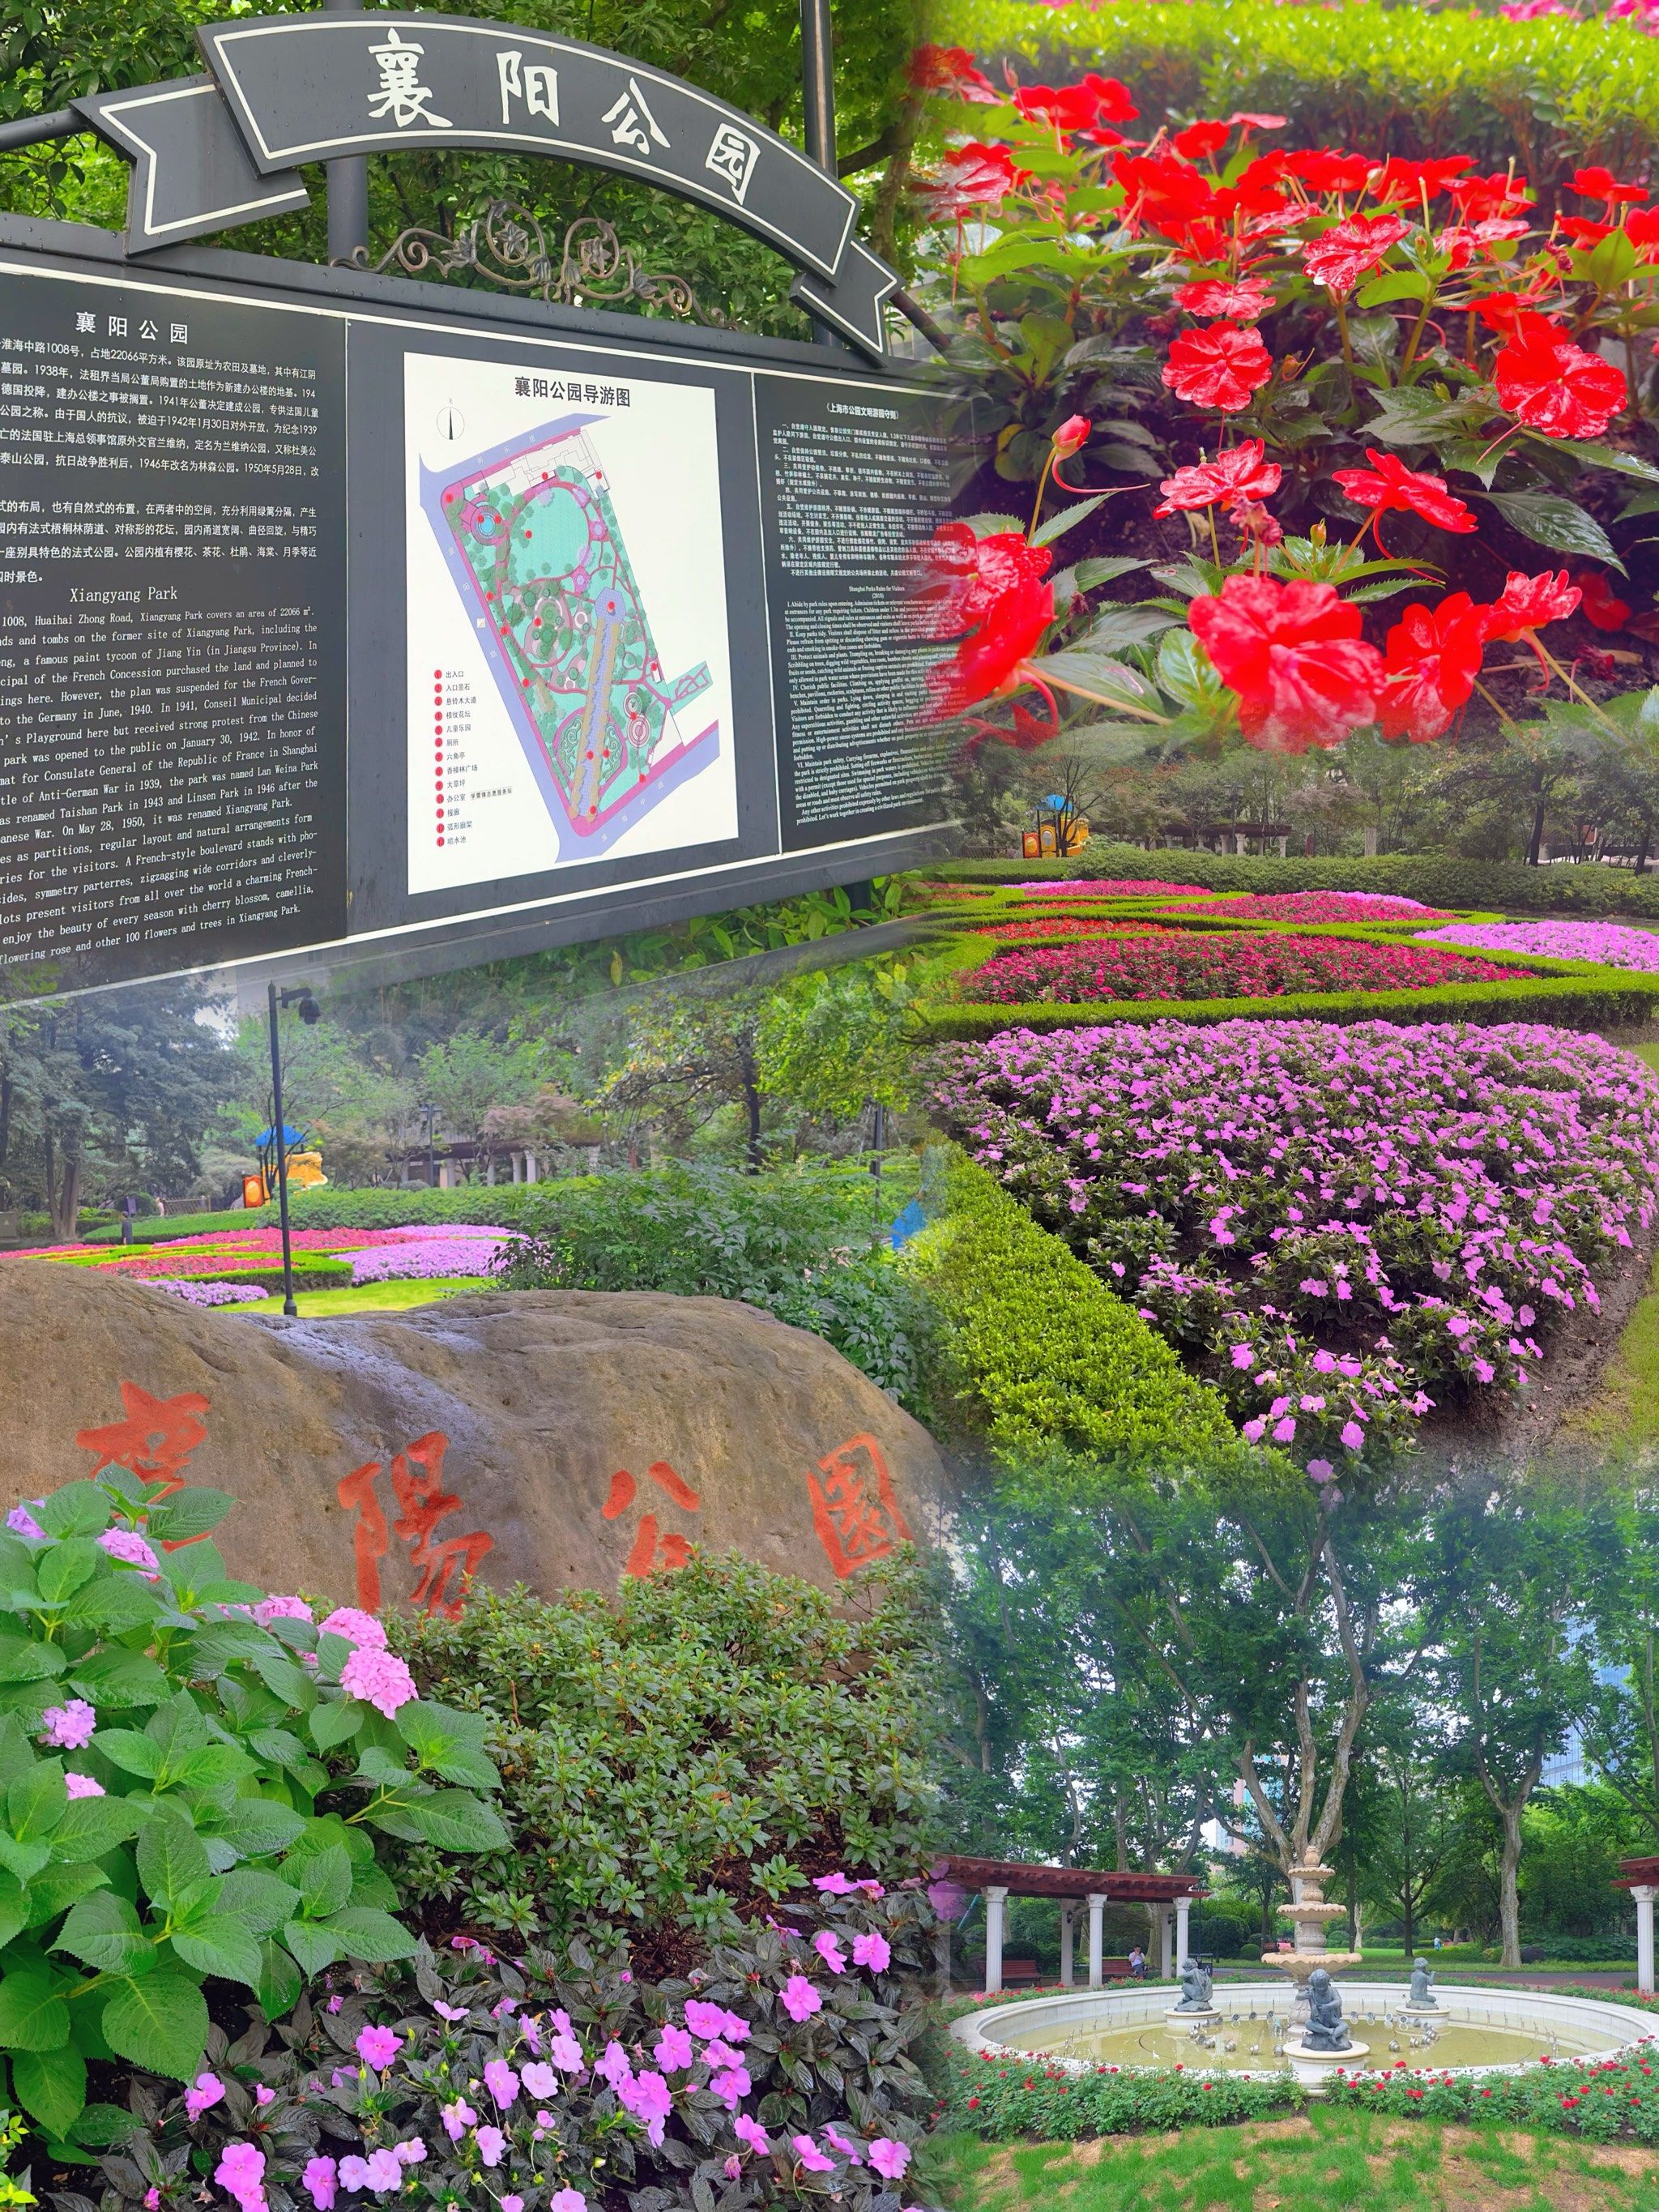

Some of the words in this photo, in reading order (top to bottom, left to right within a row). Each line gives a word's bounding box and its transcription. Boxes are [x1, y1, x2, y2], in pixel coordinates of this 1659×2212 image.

[367, 27, 761, 207] 襄阳公园
[75, 312, 188, 344] 襄阳公园
[0, 337, 316, 380] 淮海中路1008号，占地22066平方米。该园原址为农田及墓地，其中有江阴
[514, 376, 630, 408] 襄阳公园导游图
[70, 588, 141, 604] Xiangyang
[148, 586, 178, 600] Park
[2, 616, 28, 627] 1008,
[34, 614, 72, 626] Huaihai
[78, 613, 105, 625] Zhong
[109, 612, 133, 623] Road,
[140, 612, 181, 622] Xiangyang
[185, 610, 203, 620] Park
[267, 608, 277, 617] of
[279, 607, 300, 617] 22066
[18, 634, 36, 646] and
[41, 633, 69, 644] tombs
[74, 635, 85, 643] on
[91, 631, 107, 642] the
[112, 630, 143, 641] former
[147, 629, 168, 639] site
[172, 628, 182, 638] of
[186, 627, 229, 638] Xiangyang
[233, 625, 254, 635] Park,
[261, 623, 300, 634] including
[305, 622, 318, 632] the
[0, 659, 15, 668] ng,
[23, 658, 30, 666] a
[35, 654, 68, 665] famous
[73, 651, 100, 664] paint
[105, 652, 137, 663] tycoon
[141, 648, 152, 659] of
[156, 647, 182, 660] Jiang
[186, 647, 201, 656] Yin
[224, 644, 256, 655] Jiangsu
[260, 640, 302, 652] Province).
[309, 640, 318, 650] In
[34, 673, 46, 685] of
[51, 673, 68, 683] the
[72, 669, 105, 682] French
[109, 667, 161, 680] Concession
[165, 663, 210, 677] purchased
[215, 662, 228, 673] the
[233, 660, 252, 671] land
[255, 660, 270, 670] and
[273, 657, 305, 670] planned
[308, 658, 318, 666] to
[28, 694, 53, 704] here.
[60, 691, 102, 702] However,
[109, 687, 126, 698] the
[130, 685, 151, 698] plan
[156, 686, 171, 694] was
[175, 681, 220, 694] suspended
[224, 680, 237, 690] for
[242, 678, 256, 688] the
[259, 676, 287, 687] French
[290, 675, 317, 685] Gover-
[3, 753, 28, 767] park
[32, 754, 49, 762] was
[54, 747, 88, 762] opened
[93, 747, 104, 757] to
[109, 744, 126, 755] the
[130, 741, 161, 755] public
[165, 741, 177, 749] on
[181, 737, 215, 749] January
[220, 733, 232, 745] 30,
[239, 731, 260, 742] 1942.
[267, 729, 275, 740] In
[279, 728, 303, 738] honor
[305, 725, 316, 736] of
[0, 794, 17, 805] tle
[22, 792, 34, 803] of
[38, 788, 99, 801] Anti-German
[103, 784, 119, 794] War
[125, 781, 134, 792] in
[139, 778, 162, 790] 1939,
[168, 776, 184, 787] the
[188, 773, 207, 786] park
[211, 773, 226, 781] was
[230, 767, 254, 779] named
[258, 767, 271, 776] Lan
[301, 760, 318, 771] Park
[447, 793, 466, 803] 办公室
[2, 931, 32, 945] enjoy
[37, 927, 54, 939] the
[59, 922, 92, 935] beauty
[96, 917, 109, 929] of
[113, 915, 139, 926] every
[143, 909, 174, 921] season
[177, 903, 198, 915] with
[202, 899, 231, 912] cherry
[275, 884, 313, 899] camellia,
[0, 949, 45, 965] flowering
[50, 946, 71, 956] rose
[75, 939, 92, 951] and
[96, 936, 121, 948] other
[126, 931, 140, 943] 100
[144, 927, 177, 940] flowers
[181, 921, 195, 933] and
[199, 919, 222, 929] trees
[226, 916, 235, 925] in
[238, 909, 278, 923] Xiangyang
[280, 903, 301, 916] Park.
